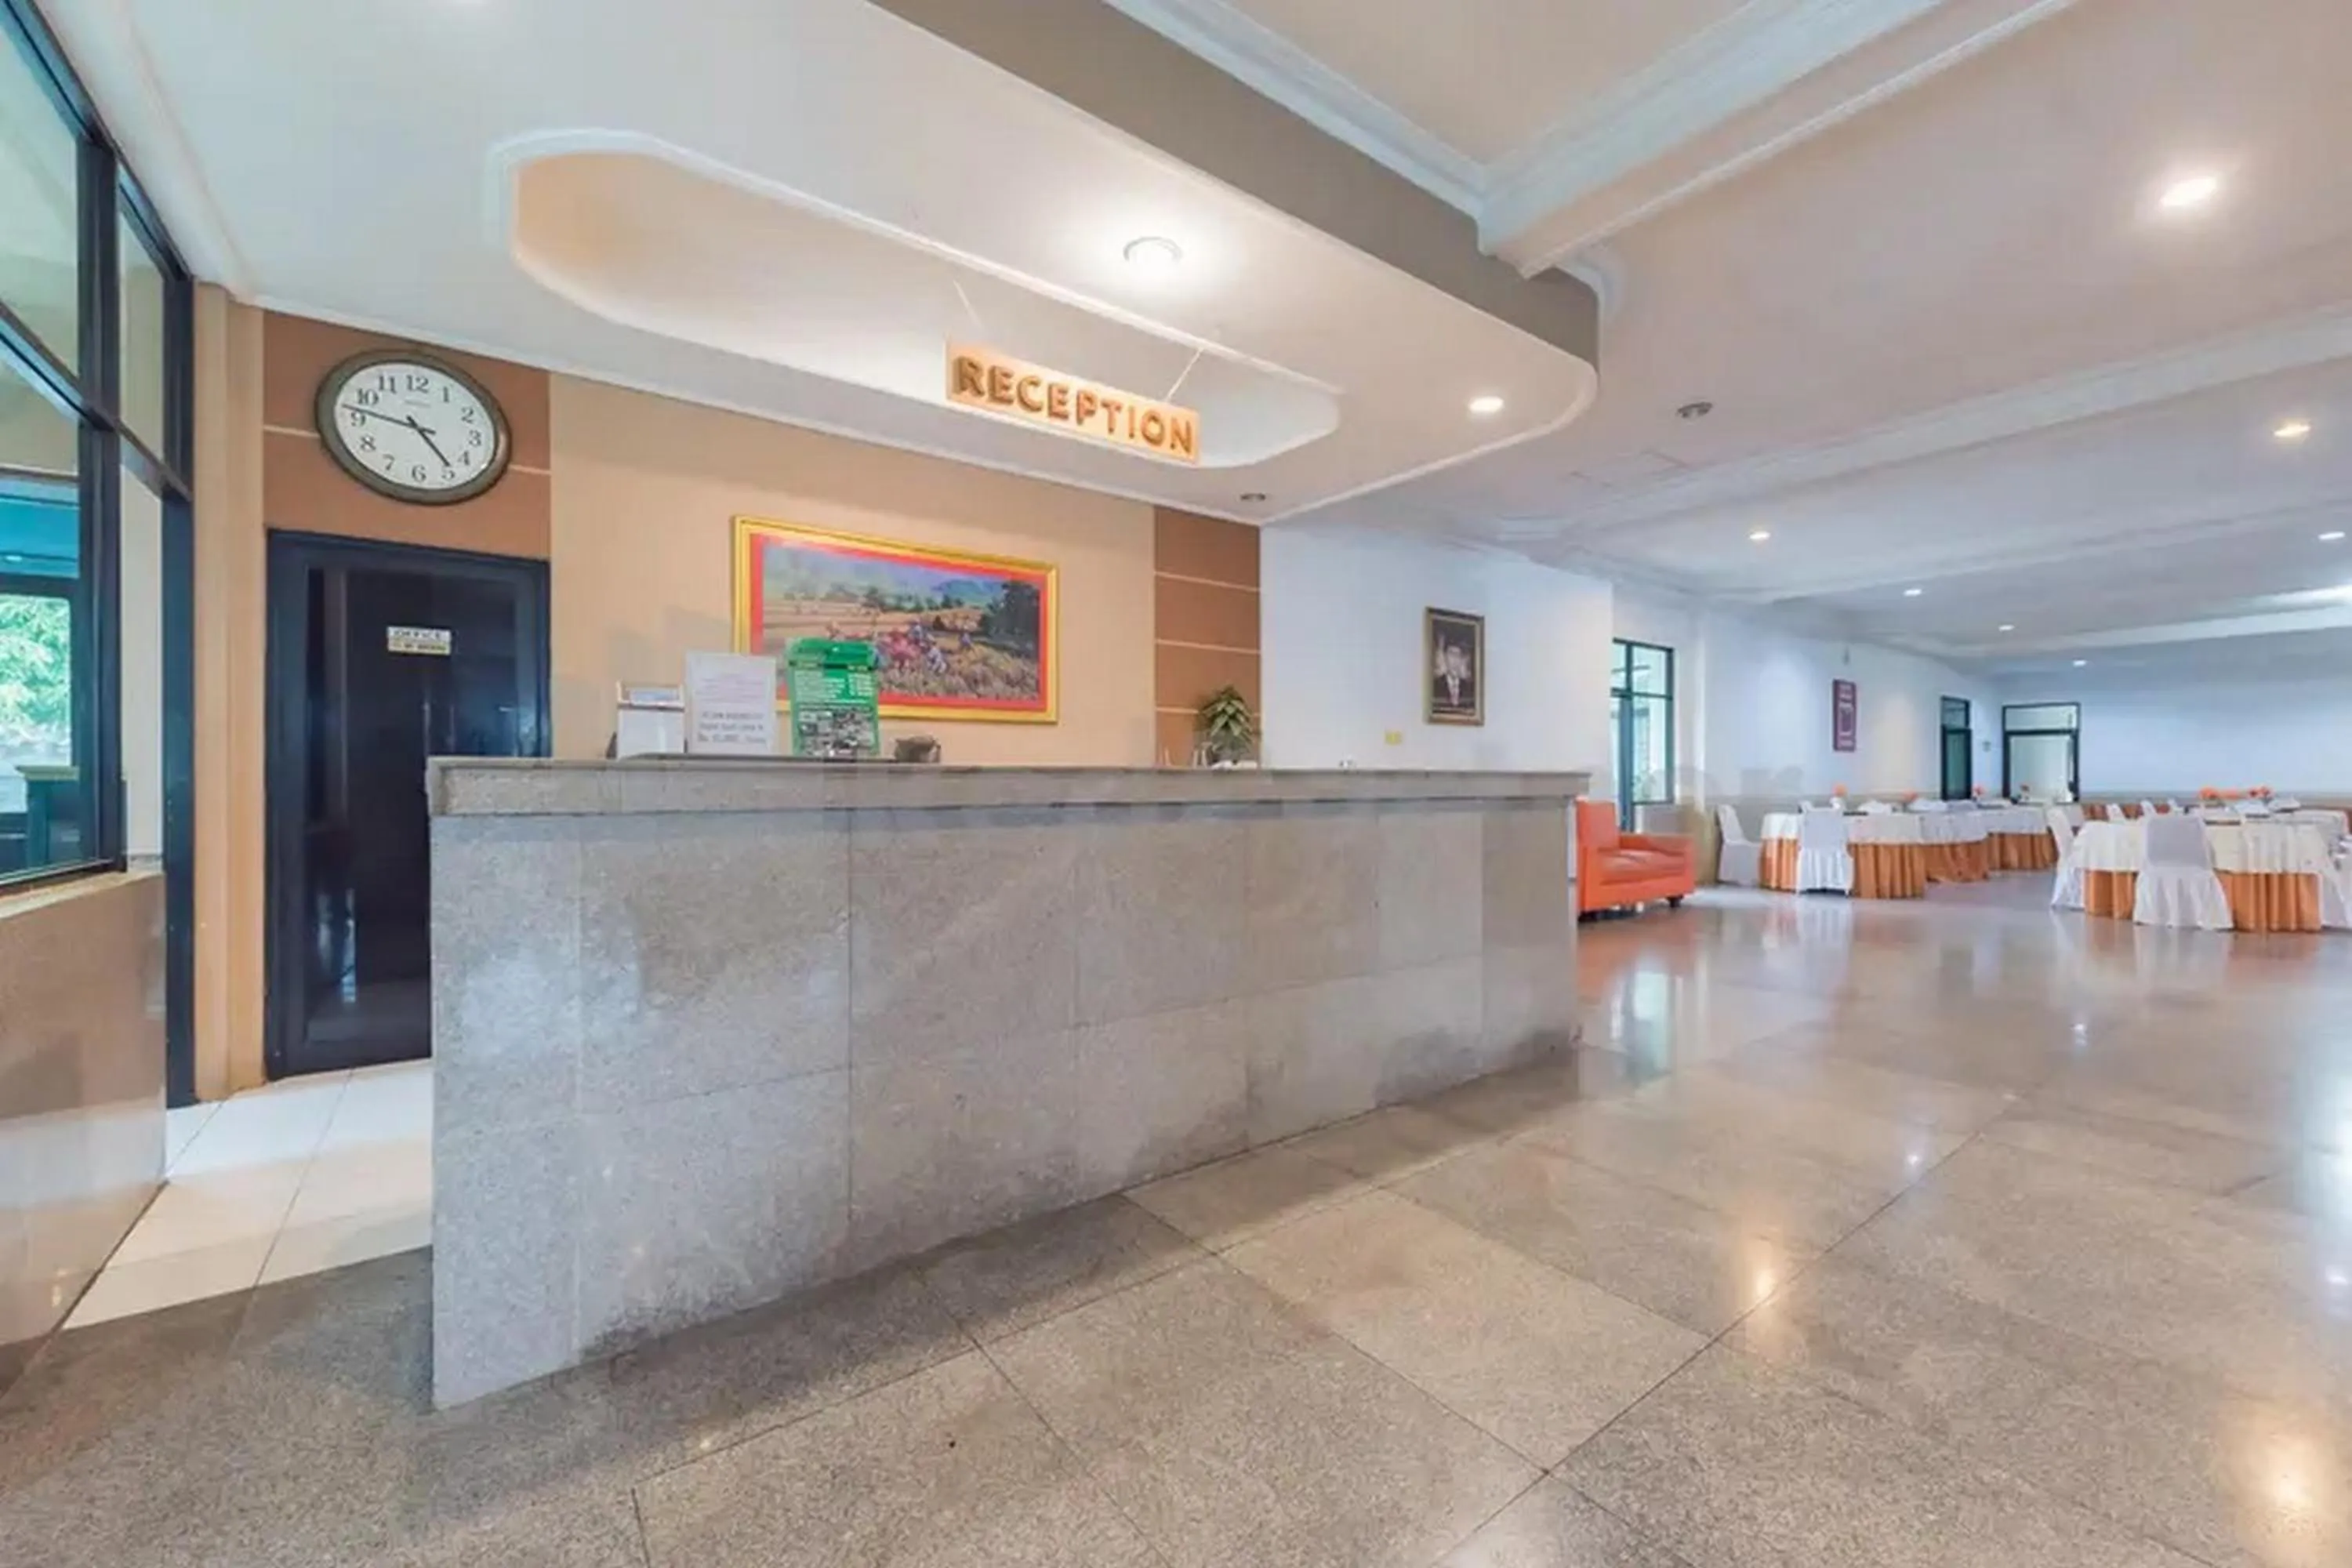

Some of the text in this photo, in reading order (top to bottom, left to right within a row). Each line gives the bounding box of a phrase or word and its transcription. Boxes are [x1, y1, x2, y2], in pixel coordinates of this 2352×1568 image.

[378, 375, 397, 394] 11
[405, 374, 430, 393] 12
[355, 388, 379, 406] 10
[441, 387, 450, 403] 1
[953, 355, 1193, 455] RECEPTION
[350, 411, 366, 427] 9
[461, 406, 474, 424] 2
[360, 435, 376, 452] 8
[469, 430, 482, 447] 3
[383, 453, 395, 470] 7
[457, 451, 470, 466] 4
[412, 465, 426, 482] 6
[441, 466, 456, 480] 5
